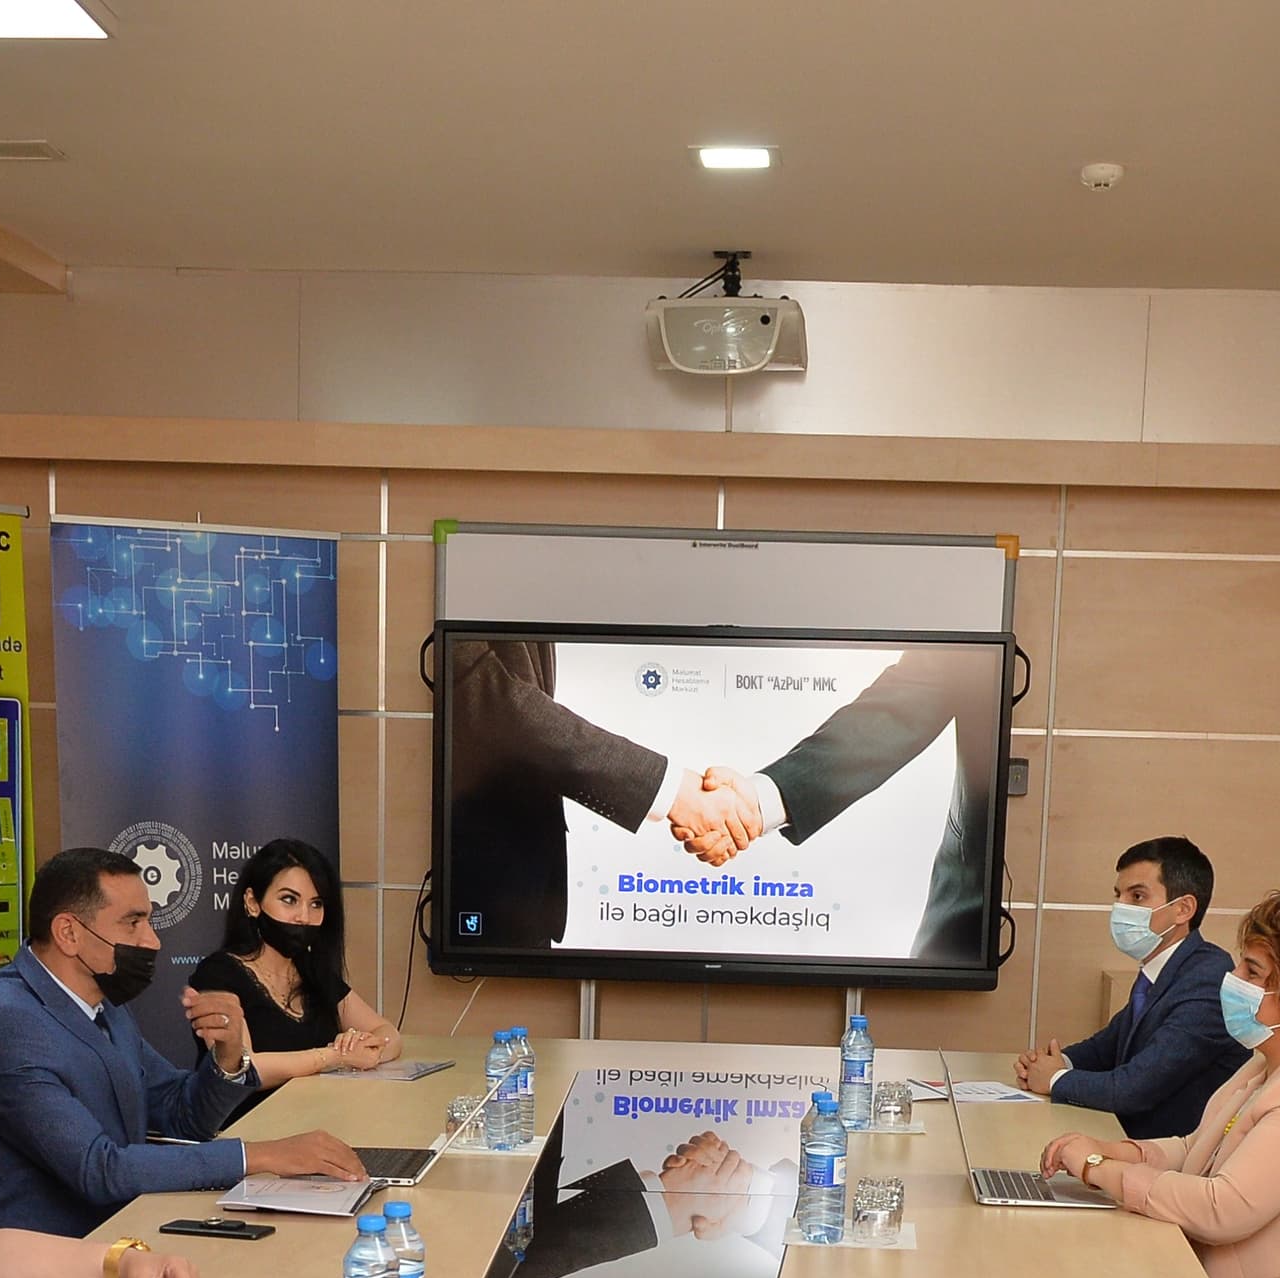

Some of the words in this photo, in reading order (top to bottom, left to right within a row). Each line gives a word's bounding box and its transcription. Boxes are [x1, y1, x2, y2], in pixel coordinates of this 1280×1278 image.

[736, 675, 764, 690] BOKT
[813, 678, 837, 692] MMC
[618, 872, 745, 896] Biometrik
[753, 875, 814, 898] imza
[600, 902, 625, 921] ilə
[632, 902, 688, 927] bağlı
[696, 906, 831, 932] əməkdaşlıq
